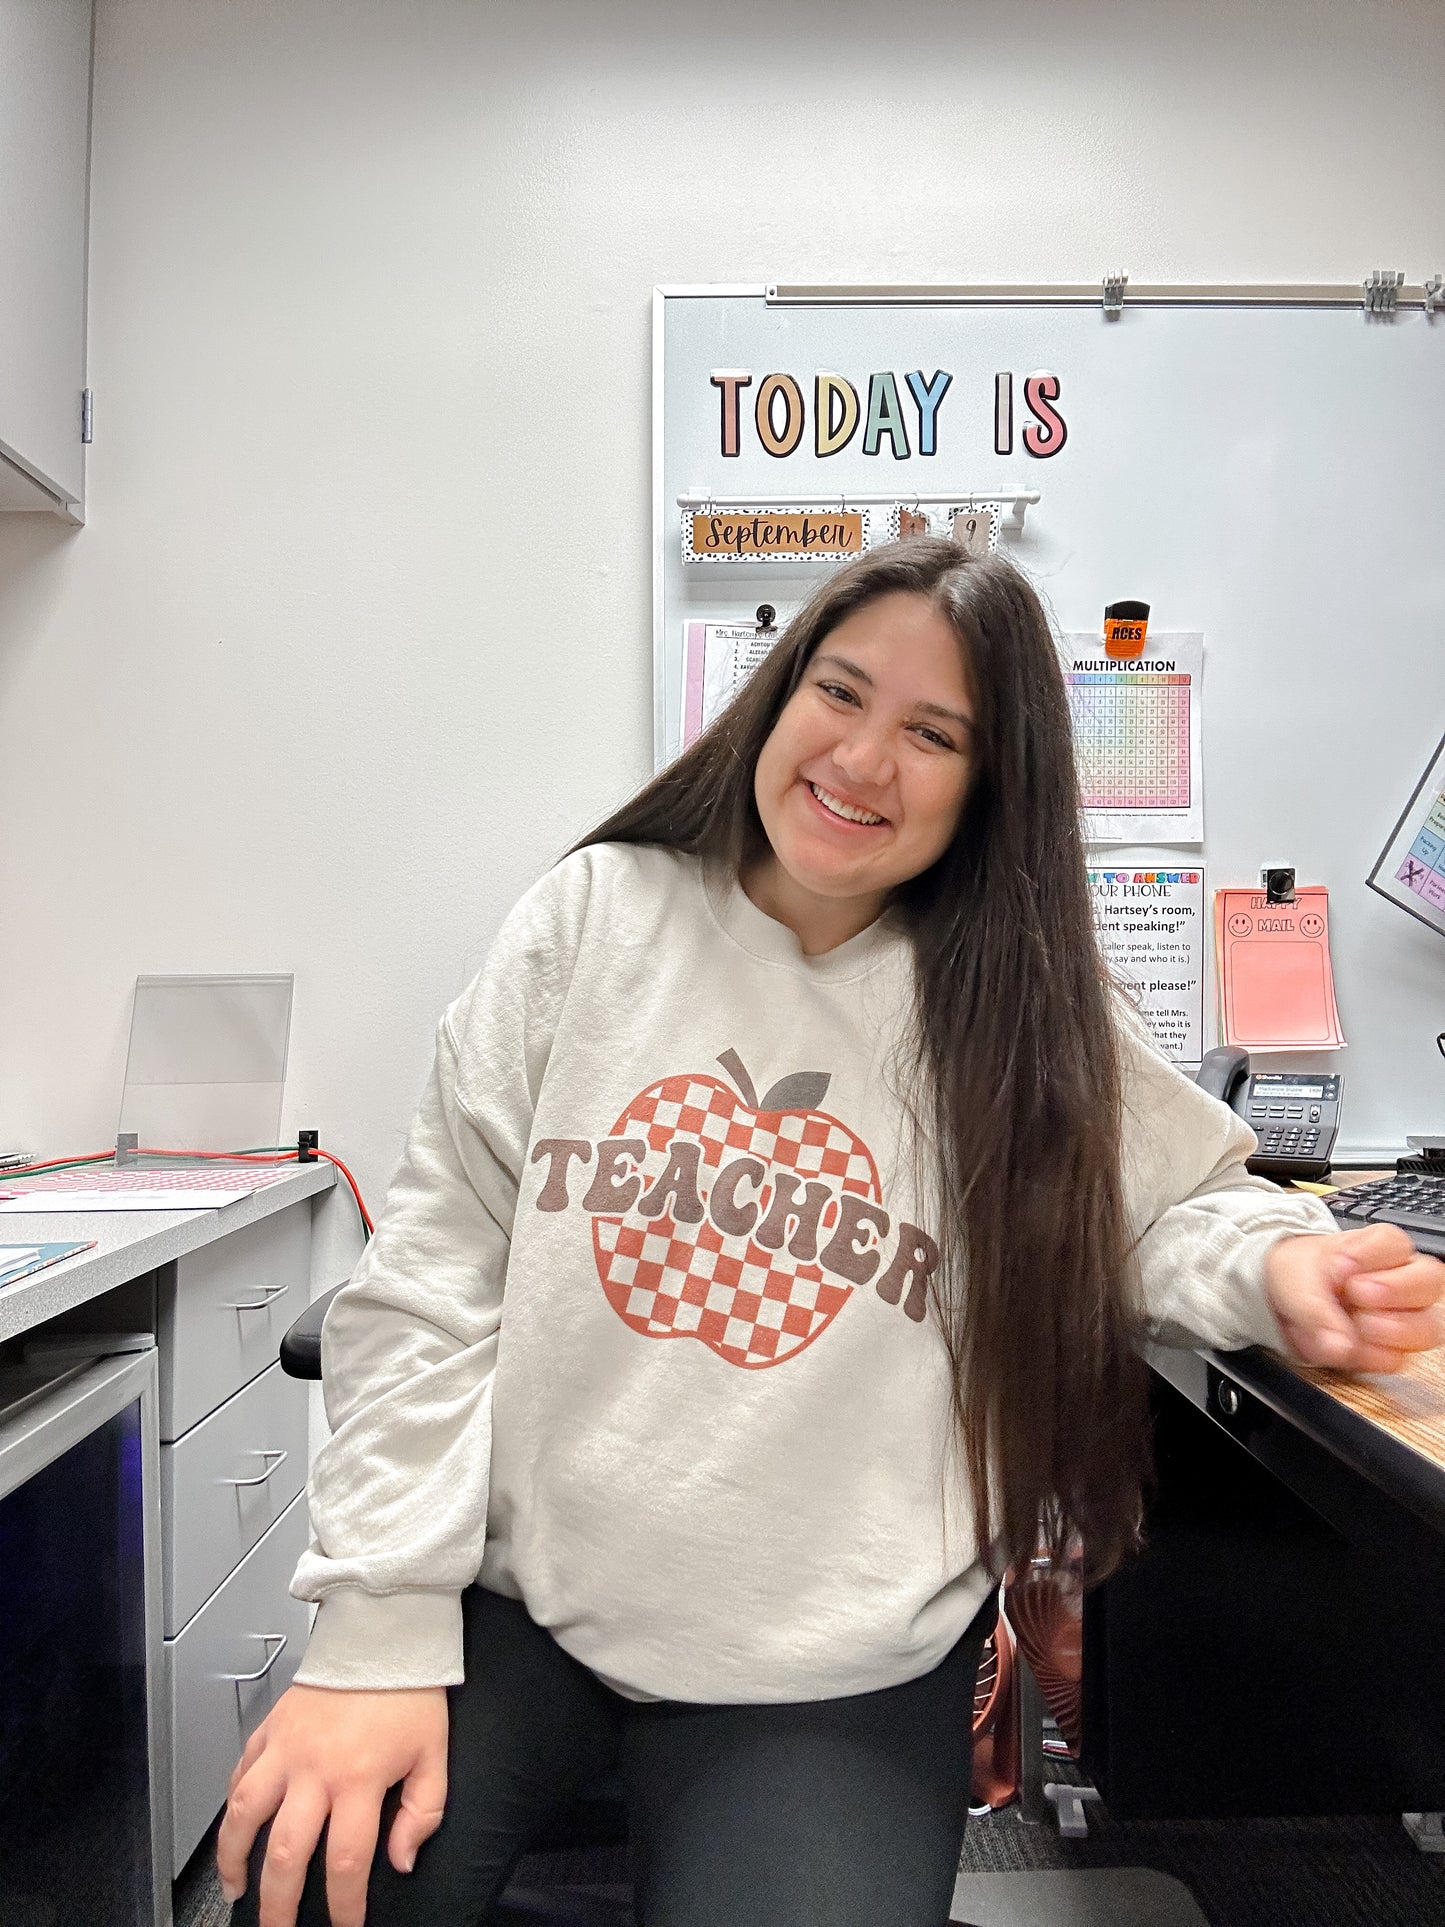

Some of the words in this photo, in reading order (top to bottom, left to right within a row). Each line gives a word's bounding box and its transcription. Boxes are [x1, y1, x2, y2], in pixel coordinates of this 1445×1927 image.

[710, 368, 952, 460] TODAY
[994, 369, 1068, 458] IS
[706, 518, 852, 553] September
[966, 519, 977, 541] 9
[1073, 660, 1176, 672] MULTIPLICATION
[1103, 872, 1130, 883] TO
[1133, 872, 1200, 884] ANSWER
[1091, 885, 1118, 897] OUR
[1124, 884, 1172, 897] PHONE
[1162, 907, 1195, 916] room,
[1095, 922, 1120, 931] dent
[1123, 921, 1186, 933] speaking!”
[1258, 919, 1295, 932] MAIL
[1128, 943, 1154, 952] speak,
[1157, 942, 1180, 951] listen
[1178, 955, 1190, 964] is.)
[1150, 980, 1196, 992] please!”
[1170, 1031, 1186, 1040] they
[530, 1137, 940, 1323] TEACHER
